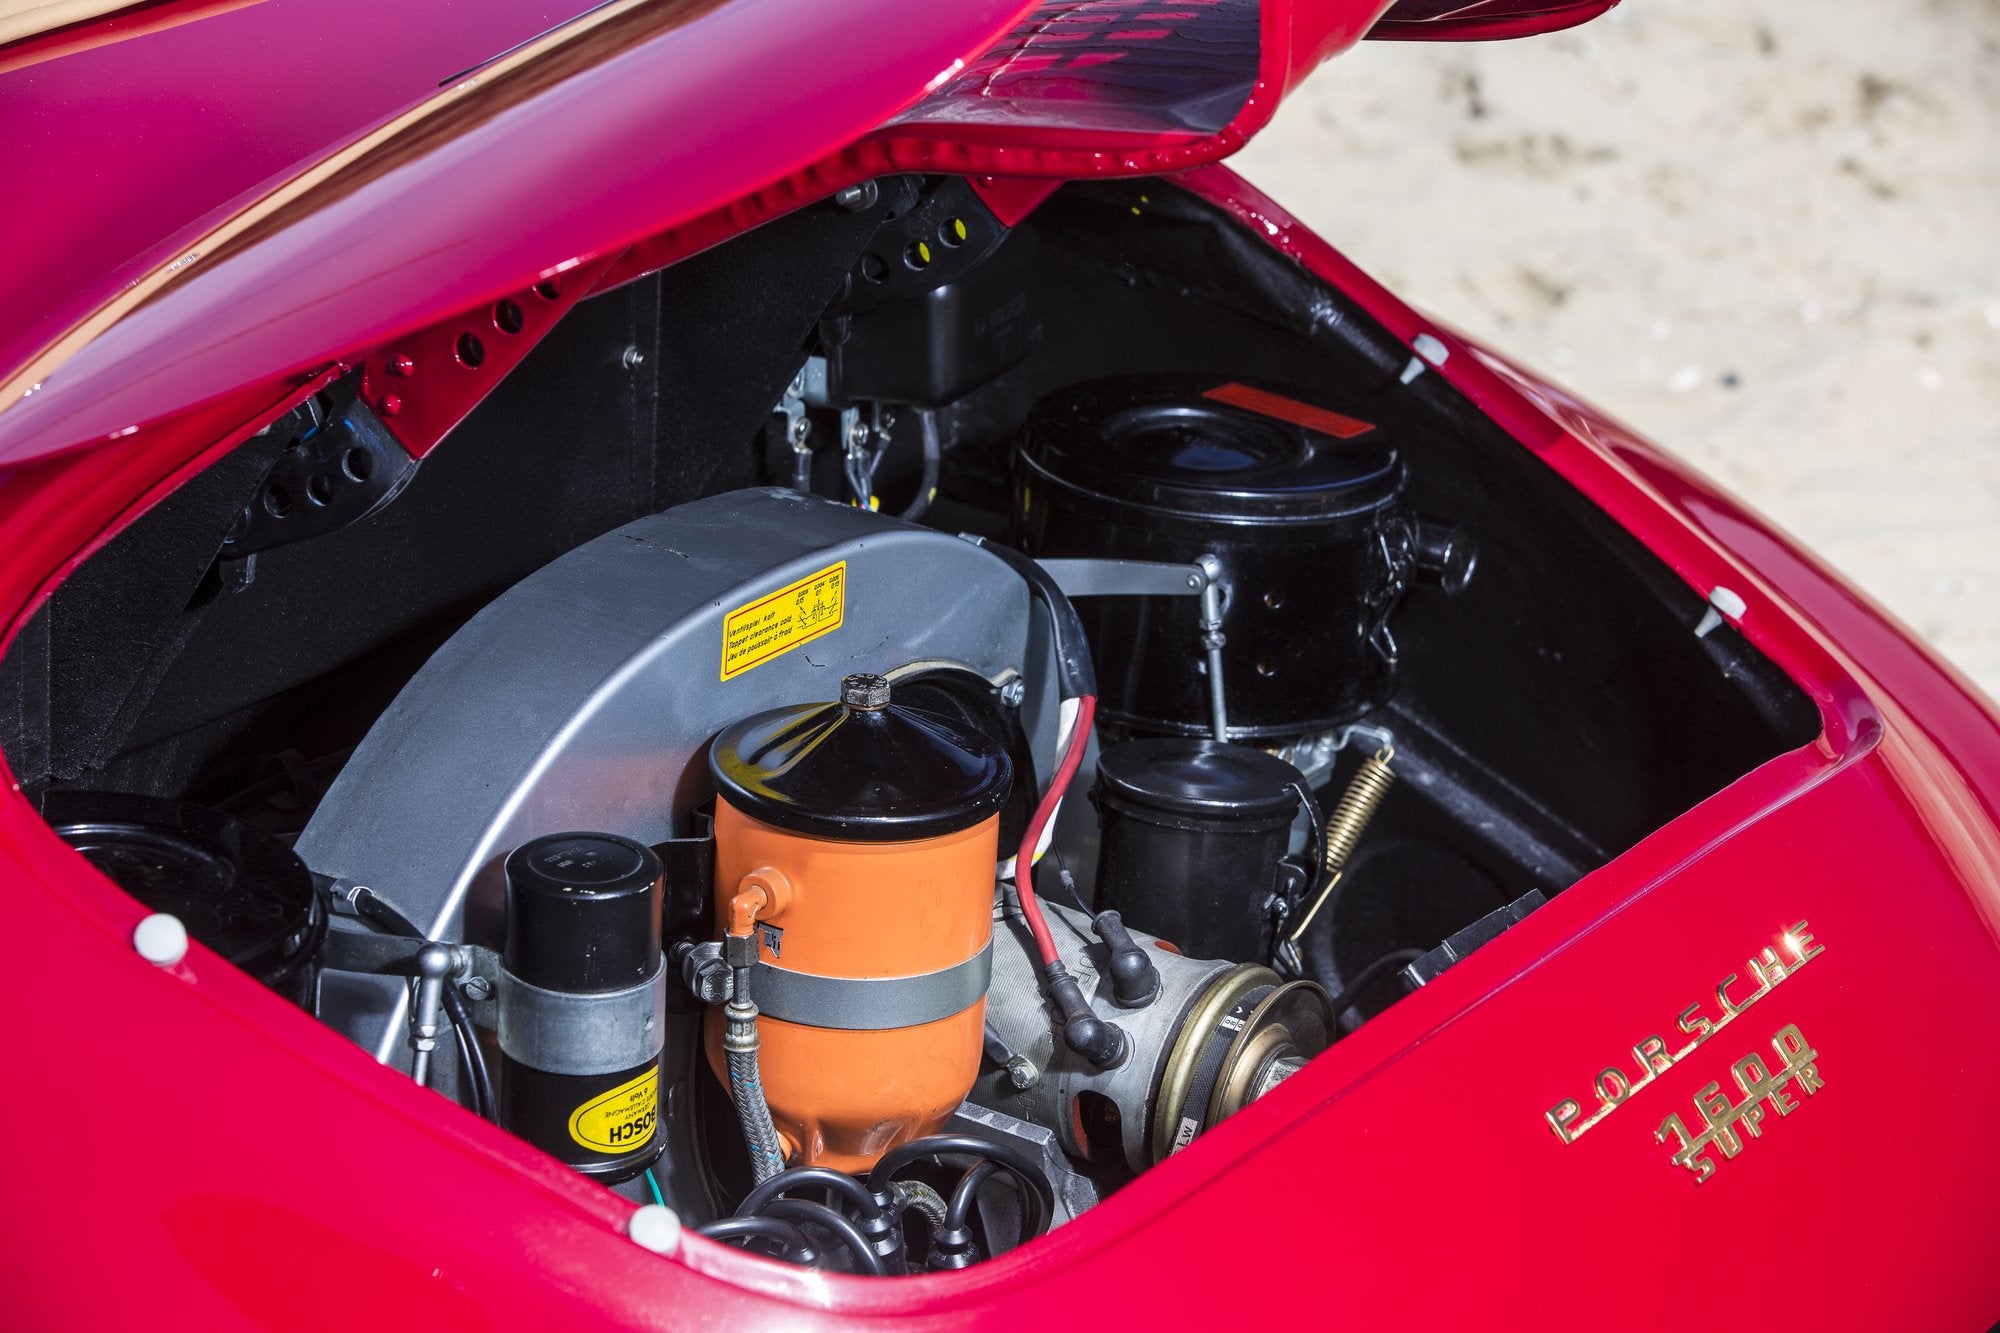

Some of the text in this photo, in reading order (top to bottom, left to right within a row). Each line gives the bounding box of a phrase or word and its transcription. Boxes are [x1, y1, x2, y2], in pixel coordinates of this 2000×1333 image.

[728, 615, 792, 650] Tappet clearance cold
[729, 611, 776, 638] Ventilspiel kalt
[727, 651, 738, 662] Jeu
[738, 647, 747, 656] de
[746, 636, 772, 656] poussoir
[778, 626, 793, 640] froid
[1544, 919, 1826, 1146] PORSCHE
[624, 1102, 651, 1120] GERMANY
[629, 1091, 643, 1102] Volt
[1655, 1023, 1818, 1165] 1600
[609, 1104, 657, 1144] BOSCH
[1681, 1062, 1826, 1185] SUPER
